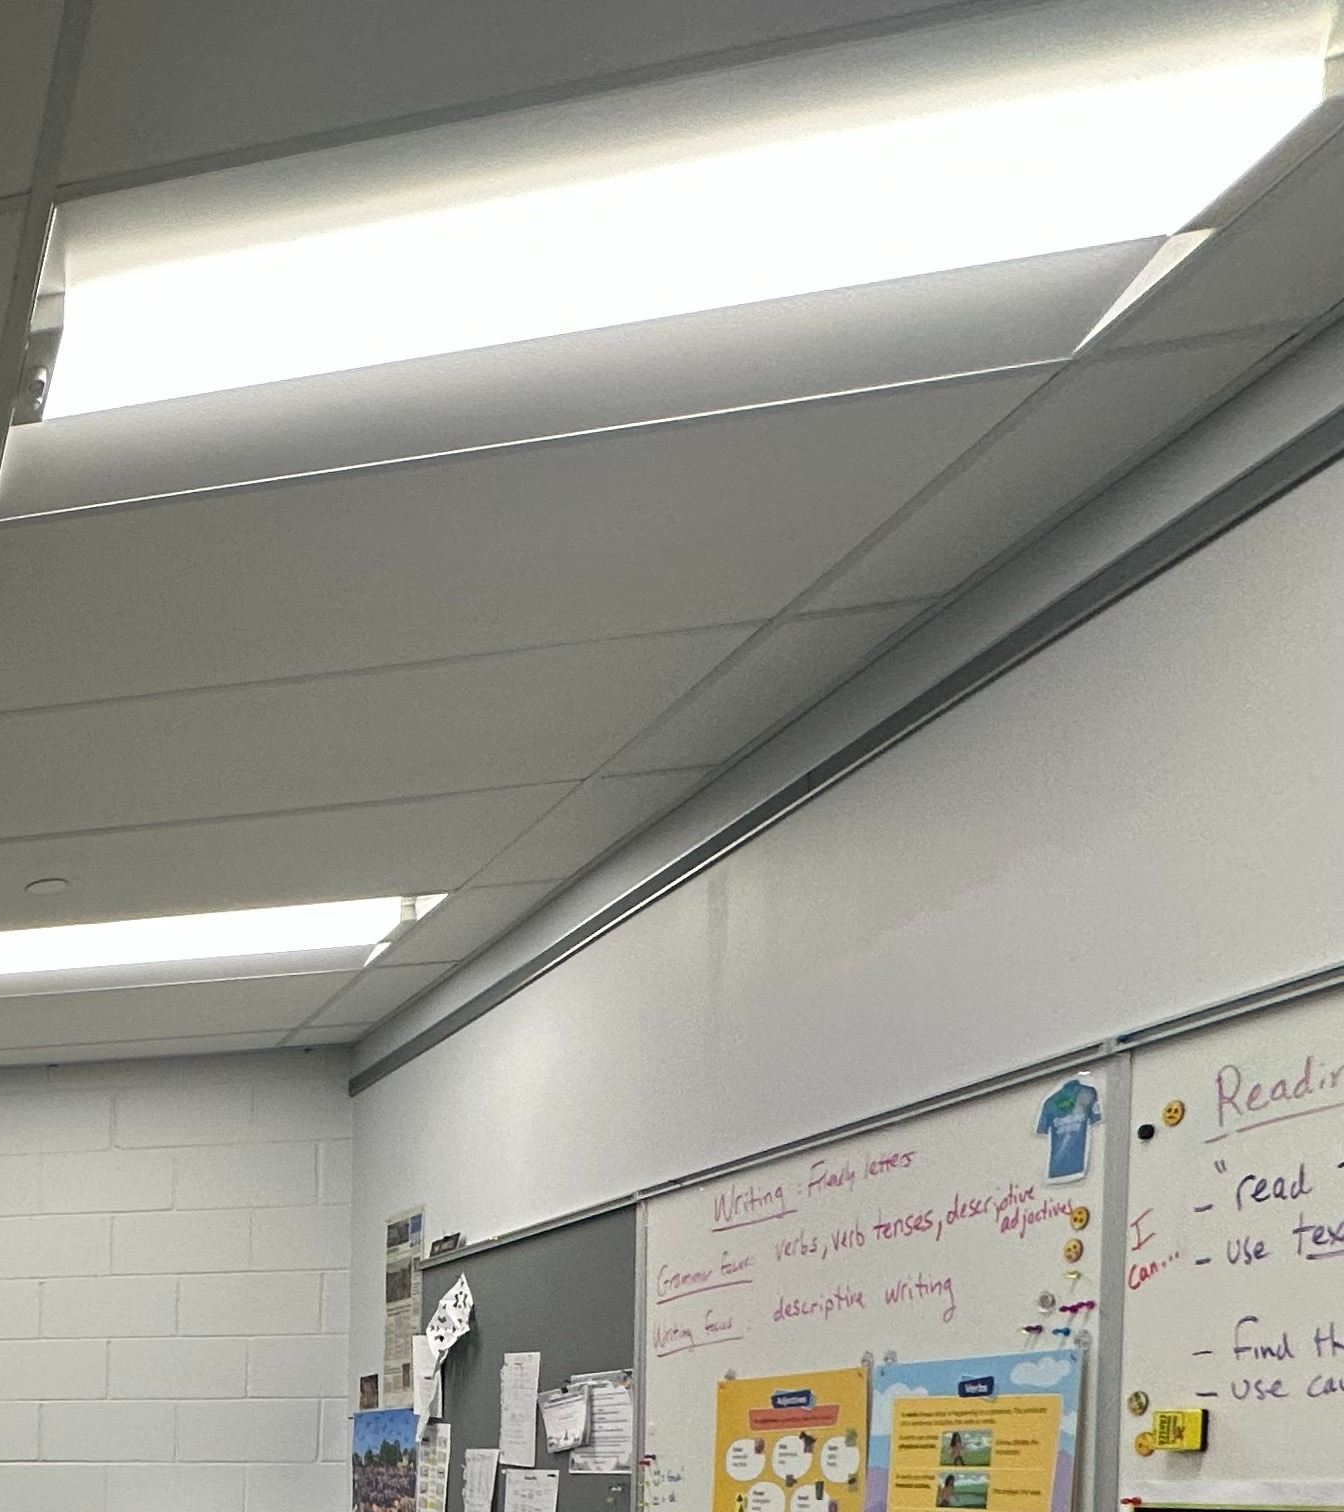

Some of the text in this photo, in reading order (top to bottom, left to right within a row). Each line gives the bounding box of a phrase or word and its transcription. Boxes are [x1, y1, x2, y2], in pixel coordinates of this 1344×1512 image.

[832, 1225, 865, 1251] verb
[773, 1275, 955, 1323] descriptive writing
